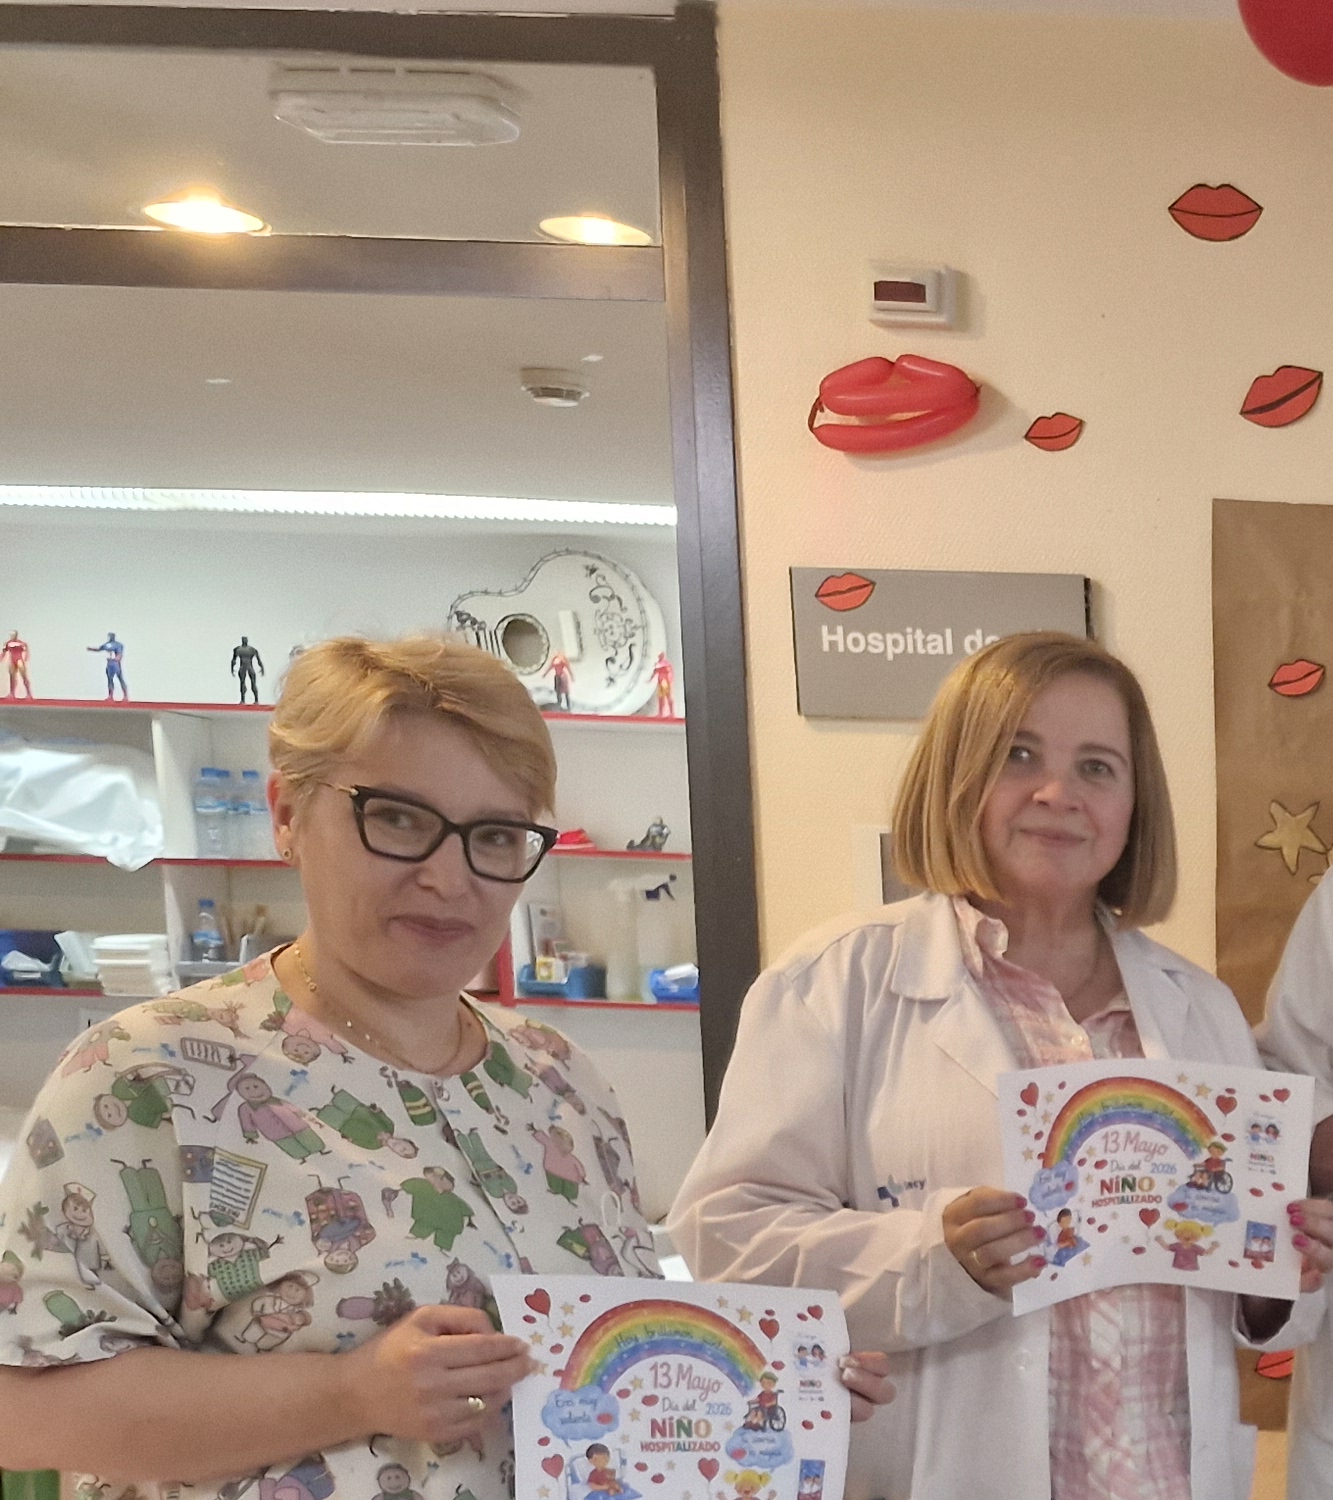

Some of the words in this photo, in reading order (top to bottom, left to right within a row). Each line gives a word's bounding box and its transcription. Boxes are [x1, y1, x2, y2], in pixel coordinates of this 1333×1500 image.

[820, 625, 954, 661] Hospital
[1101, 1130, 1120, 1154] 13
[1123, 1130, 1169, 1163] Mayo
[649, 1361, 672, 1389] 13
[675, 1363, 724, 1402] Mayo
